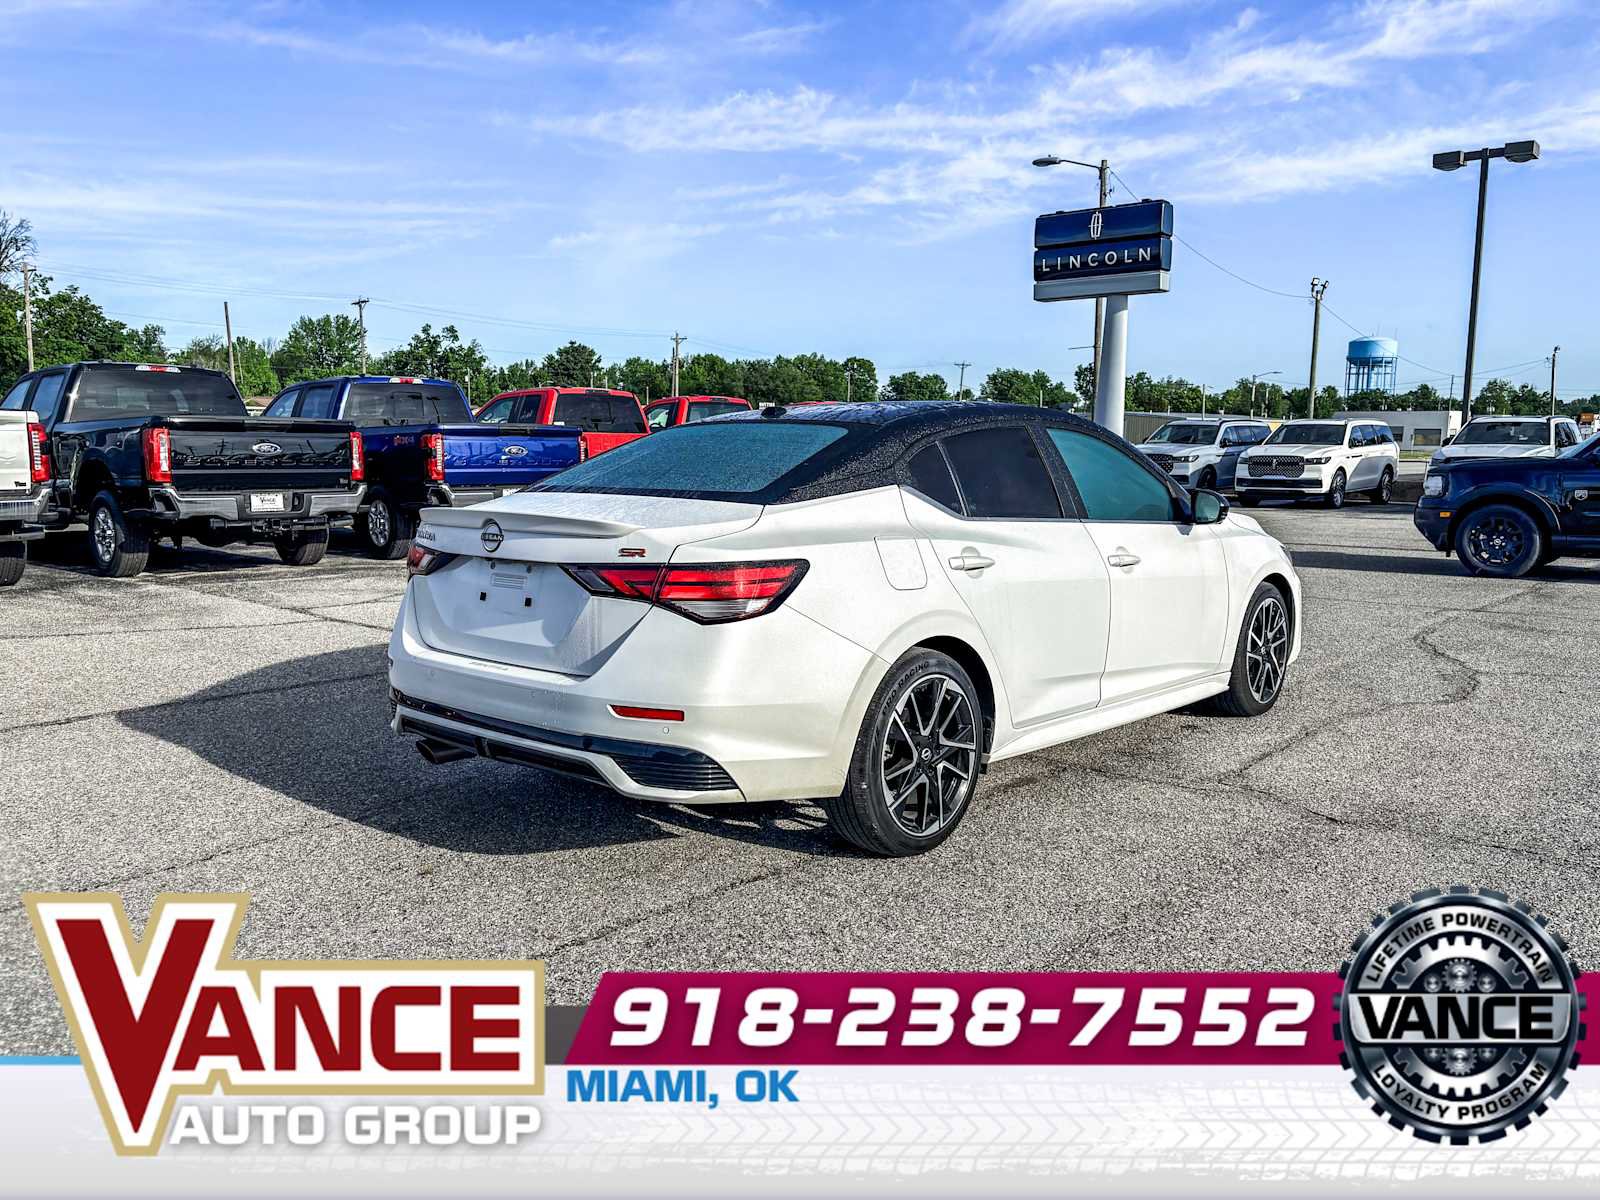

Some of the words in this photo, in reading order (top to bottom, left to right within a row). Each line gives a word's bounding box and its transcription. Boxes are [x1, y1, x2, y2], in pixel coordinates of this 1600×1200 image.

[1042, 247, 1152, 272] LINCOLN
[618, 548, 646, 557] SR
[898, 661, 929, 688] RACING
